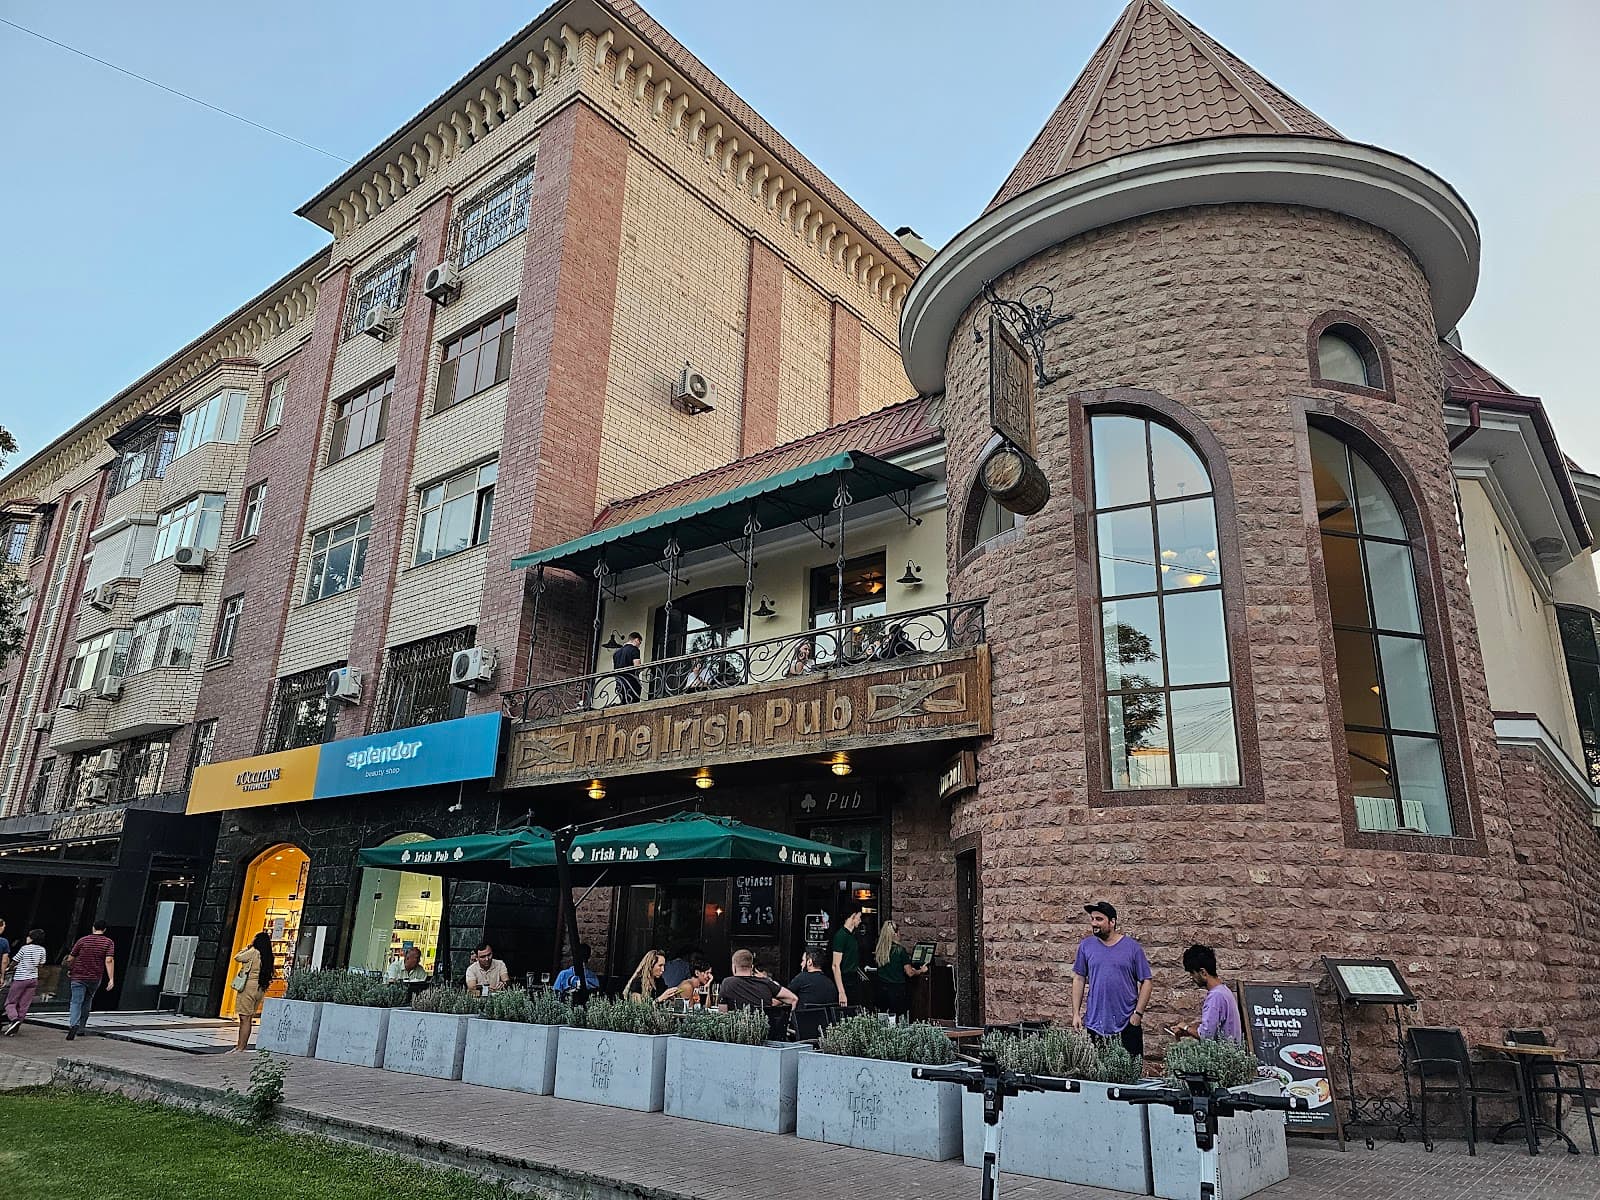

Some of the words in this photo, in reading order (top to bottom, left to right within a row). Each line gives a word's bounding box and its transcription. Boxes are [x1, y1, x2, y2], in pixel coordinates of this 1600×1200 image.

[584, 723, 652, 764] The
[660, 704, 753, 755] Irish
[765, 689, 853, 740] Pub
[346, 740, 422, 770] splendor
[365, 769, 385, 778] beauty
[385, 767, 401, 777] shop
[826, 790, 861, 810] Pub
[414, 850, 432, 863] Irish
[434, 849, 449, 862] Pub
[590, 848, 615, 862] Irish
[619, 847, 639, 861] Pub
[791, 850, 808, 865] Irish
[809, 853, 821, 866] Pub
[1253, 1004, 1308, 1017] Business
[1263, 1017, 1302, 1029] Lunch
[848, 1091, 882, 1113] Irish
[853, 1109, 878, 1131] Pub
